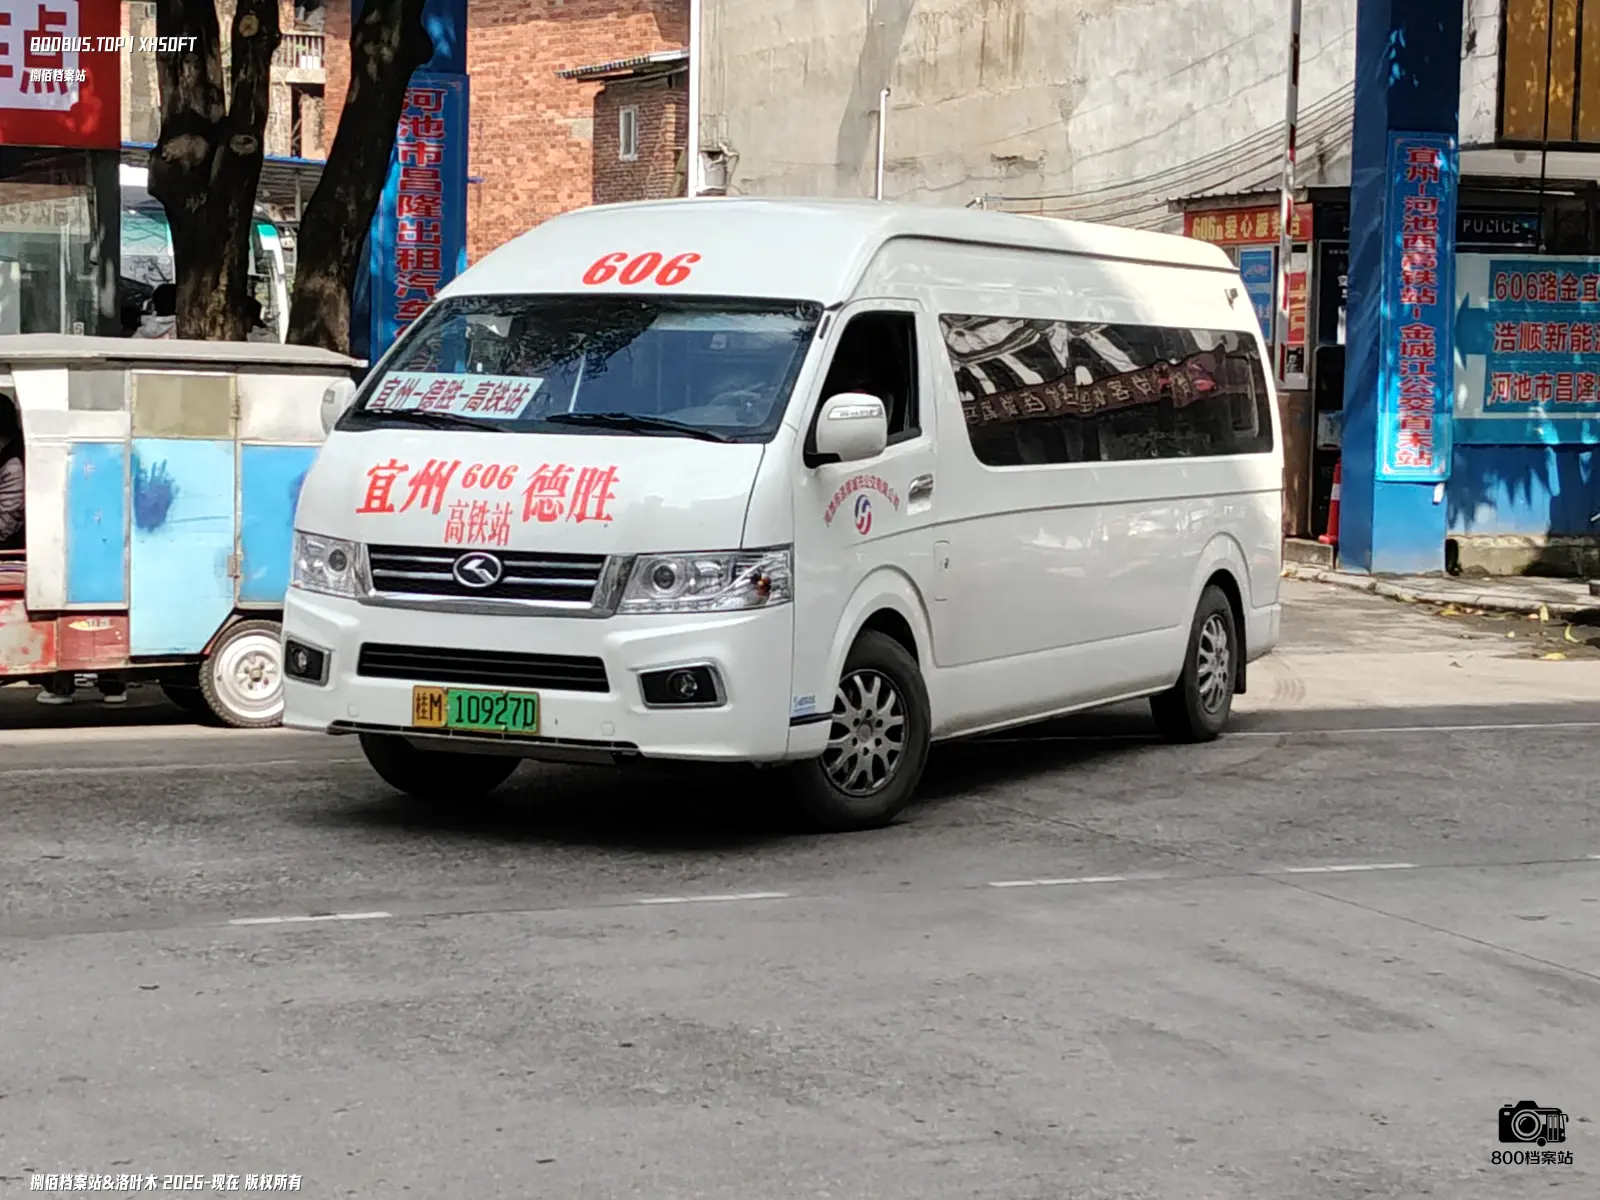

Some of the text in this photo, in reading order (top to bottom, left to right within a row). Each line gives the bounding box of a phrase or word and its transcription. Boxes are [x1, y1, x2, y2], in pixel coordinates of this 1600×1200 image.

[394, 88, 448, 337] 河池市昌隆出租汽车
[1462, 219, 1521, 234] POLICE
[582, 252, 702, 286] 606
[1489, 371, 1600, 405] 河池市昌隆
[356, 459, 620, 523] 宜州 606 德胜
[444, 499, 513, 546] 高铁站
